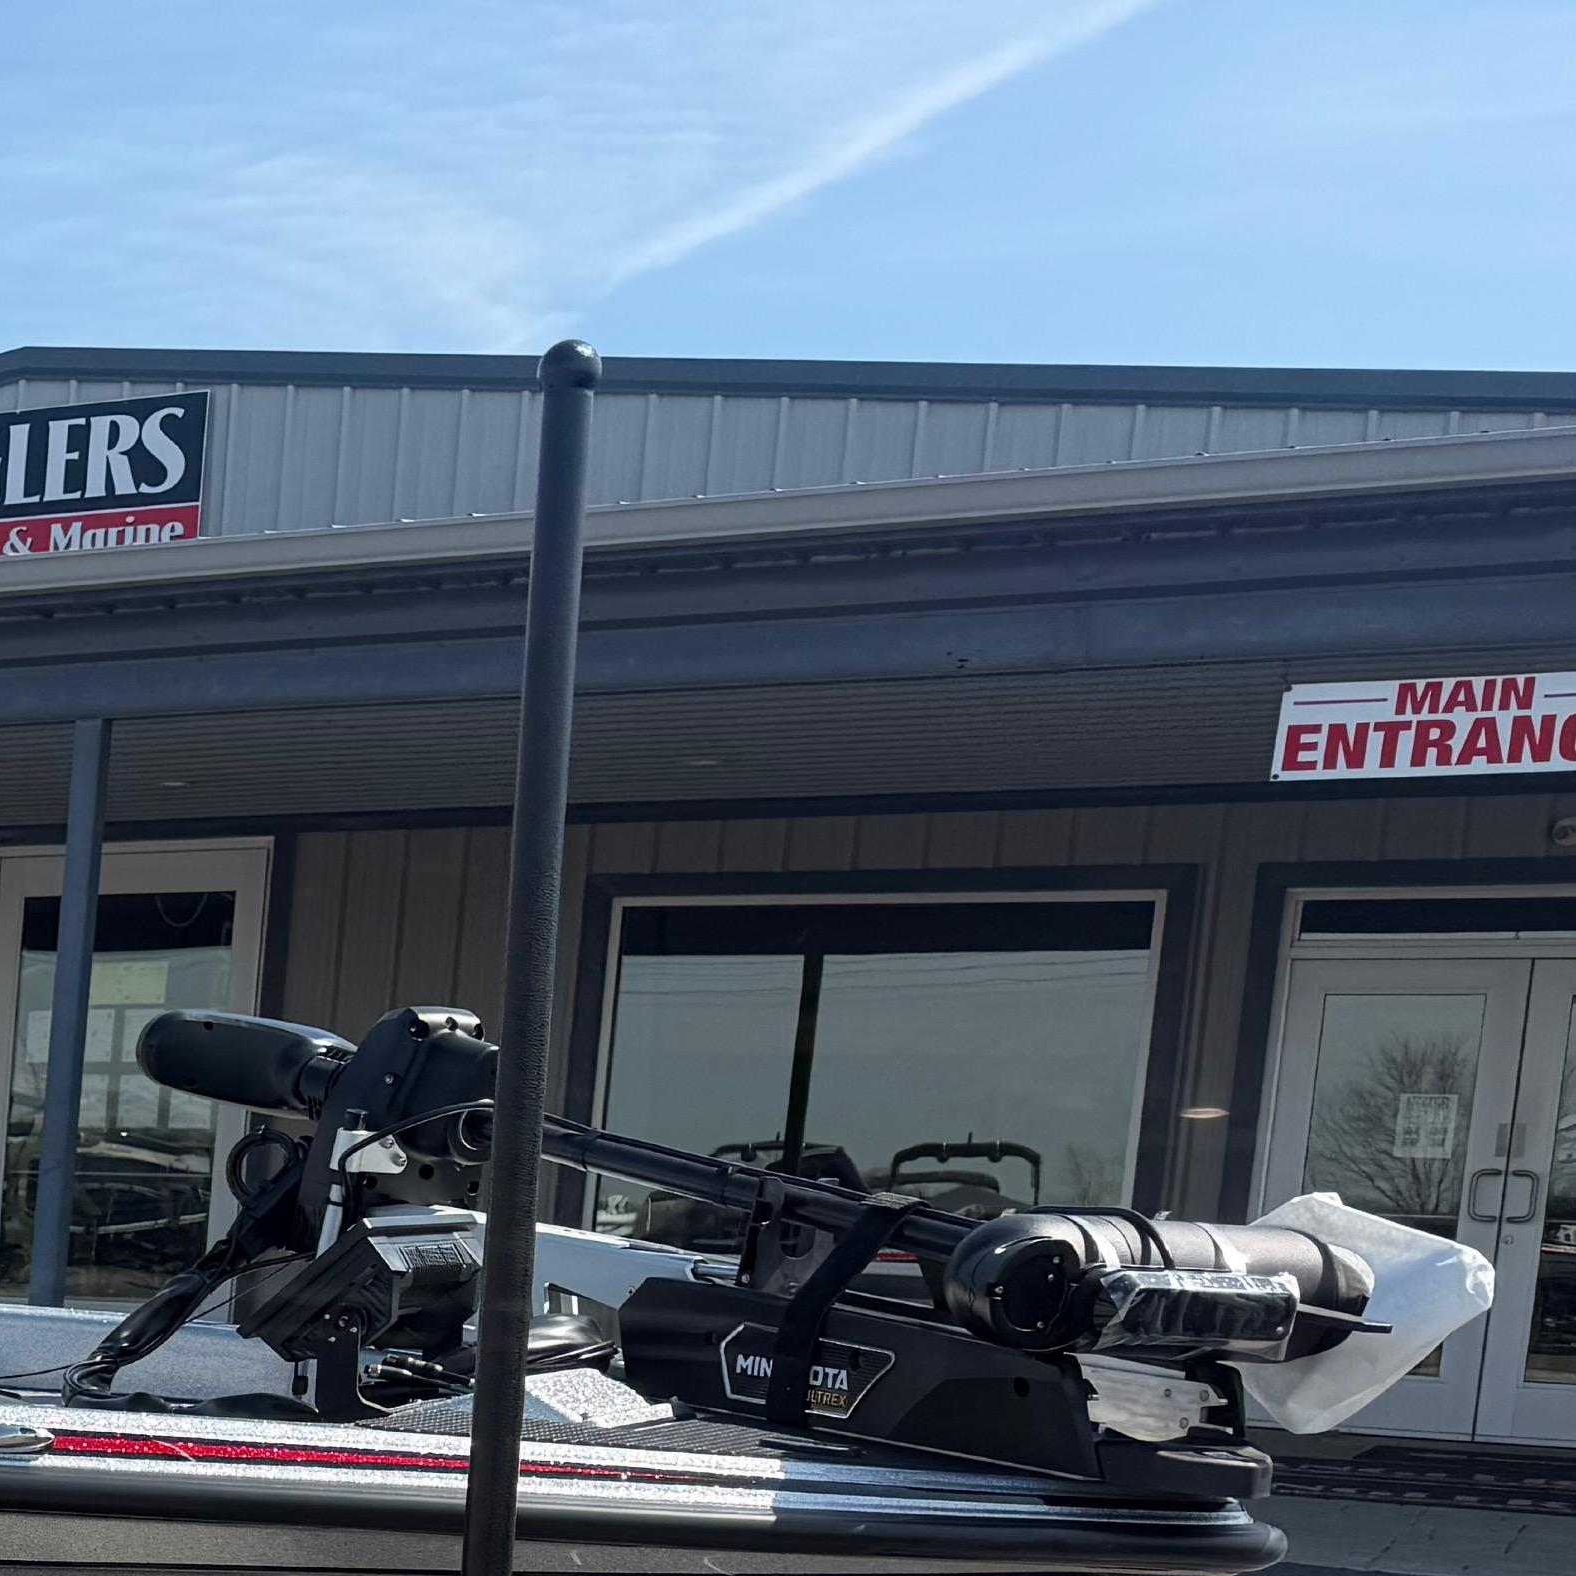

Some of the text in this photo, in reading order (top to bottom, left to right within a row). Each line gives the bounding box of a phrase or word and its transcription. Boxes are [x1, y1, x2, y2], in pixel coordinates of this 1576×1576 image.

[2, 526, 33, 556] &
[49, 515, 184, 551] Marine
[1395, 676, 1536, 716] MAIN
